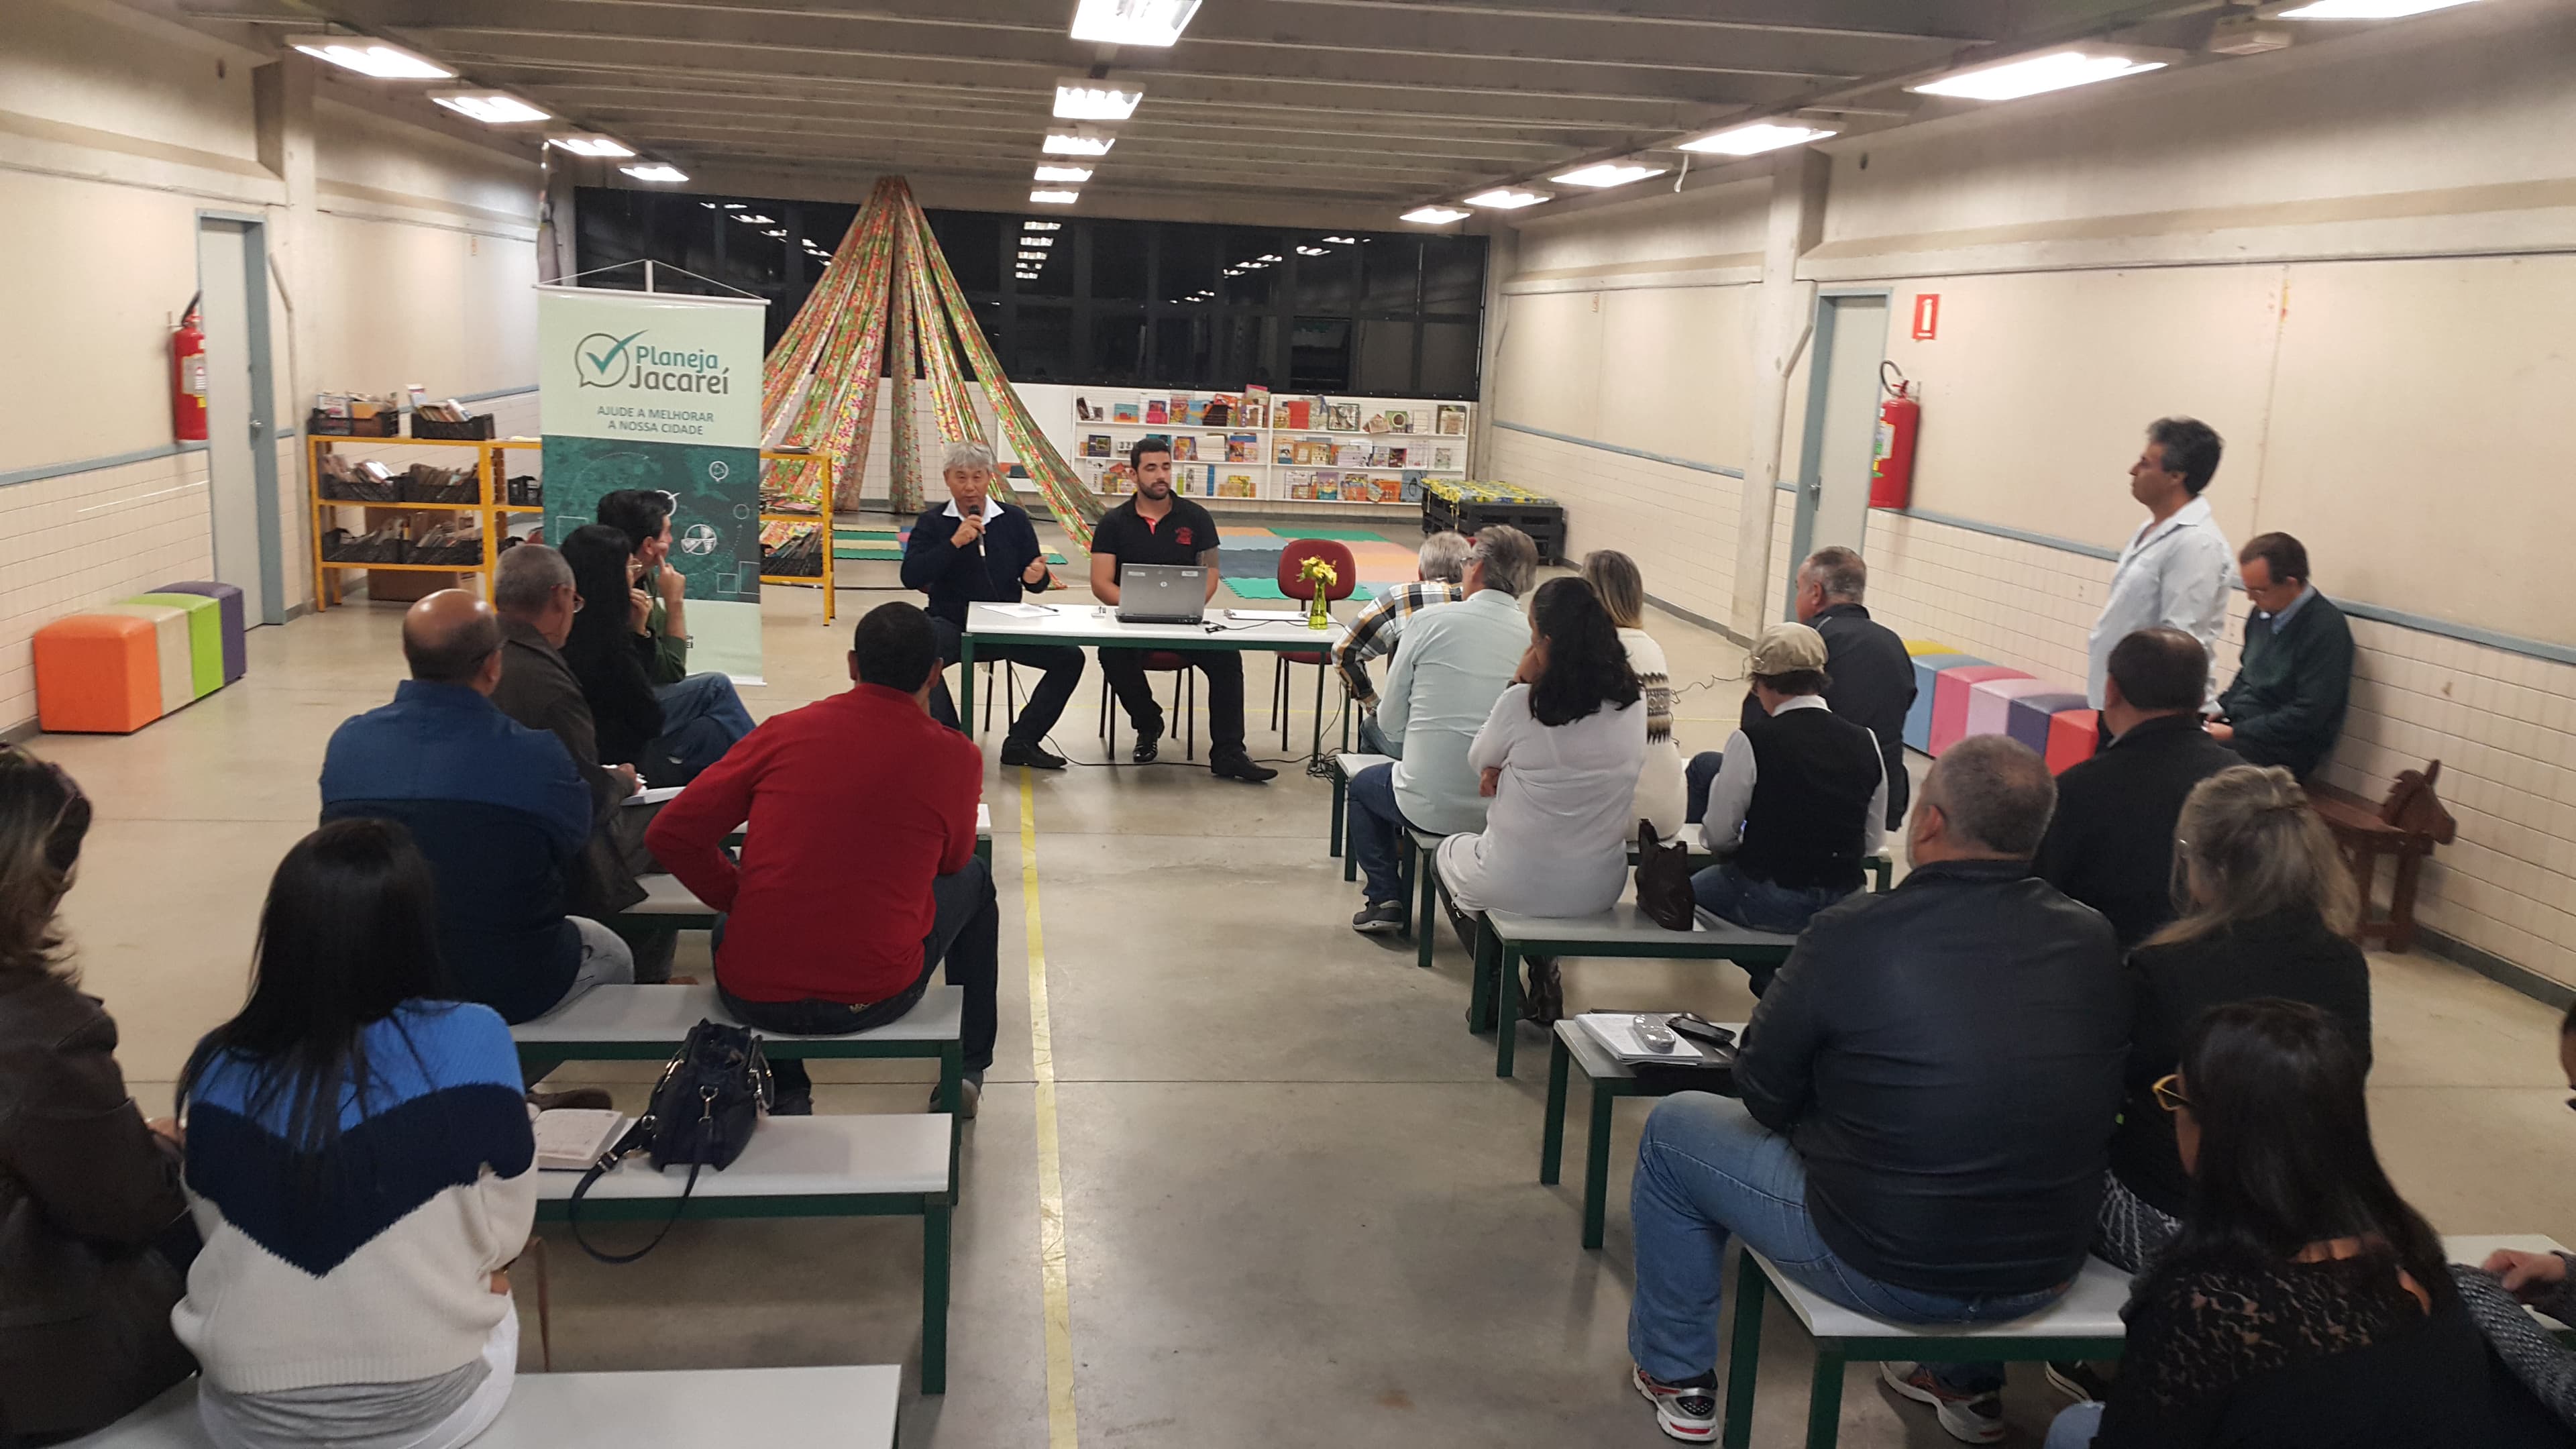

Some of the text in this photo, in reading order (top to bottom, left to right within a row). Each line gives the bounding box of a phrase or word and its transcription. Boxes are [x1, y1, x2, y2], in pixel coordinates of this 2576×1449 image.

[636, 345, 718, 374] Planeja
[629, 365, 729, 394] Jacareí
[596, 405, 714, 423] AJUDE A MELHORAR
[608, 420, 704, 435] A NOSSA CIDADE
